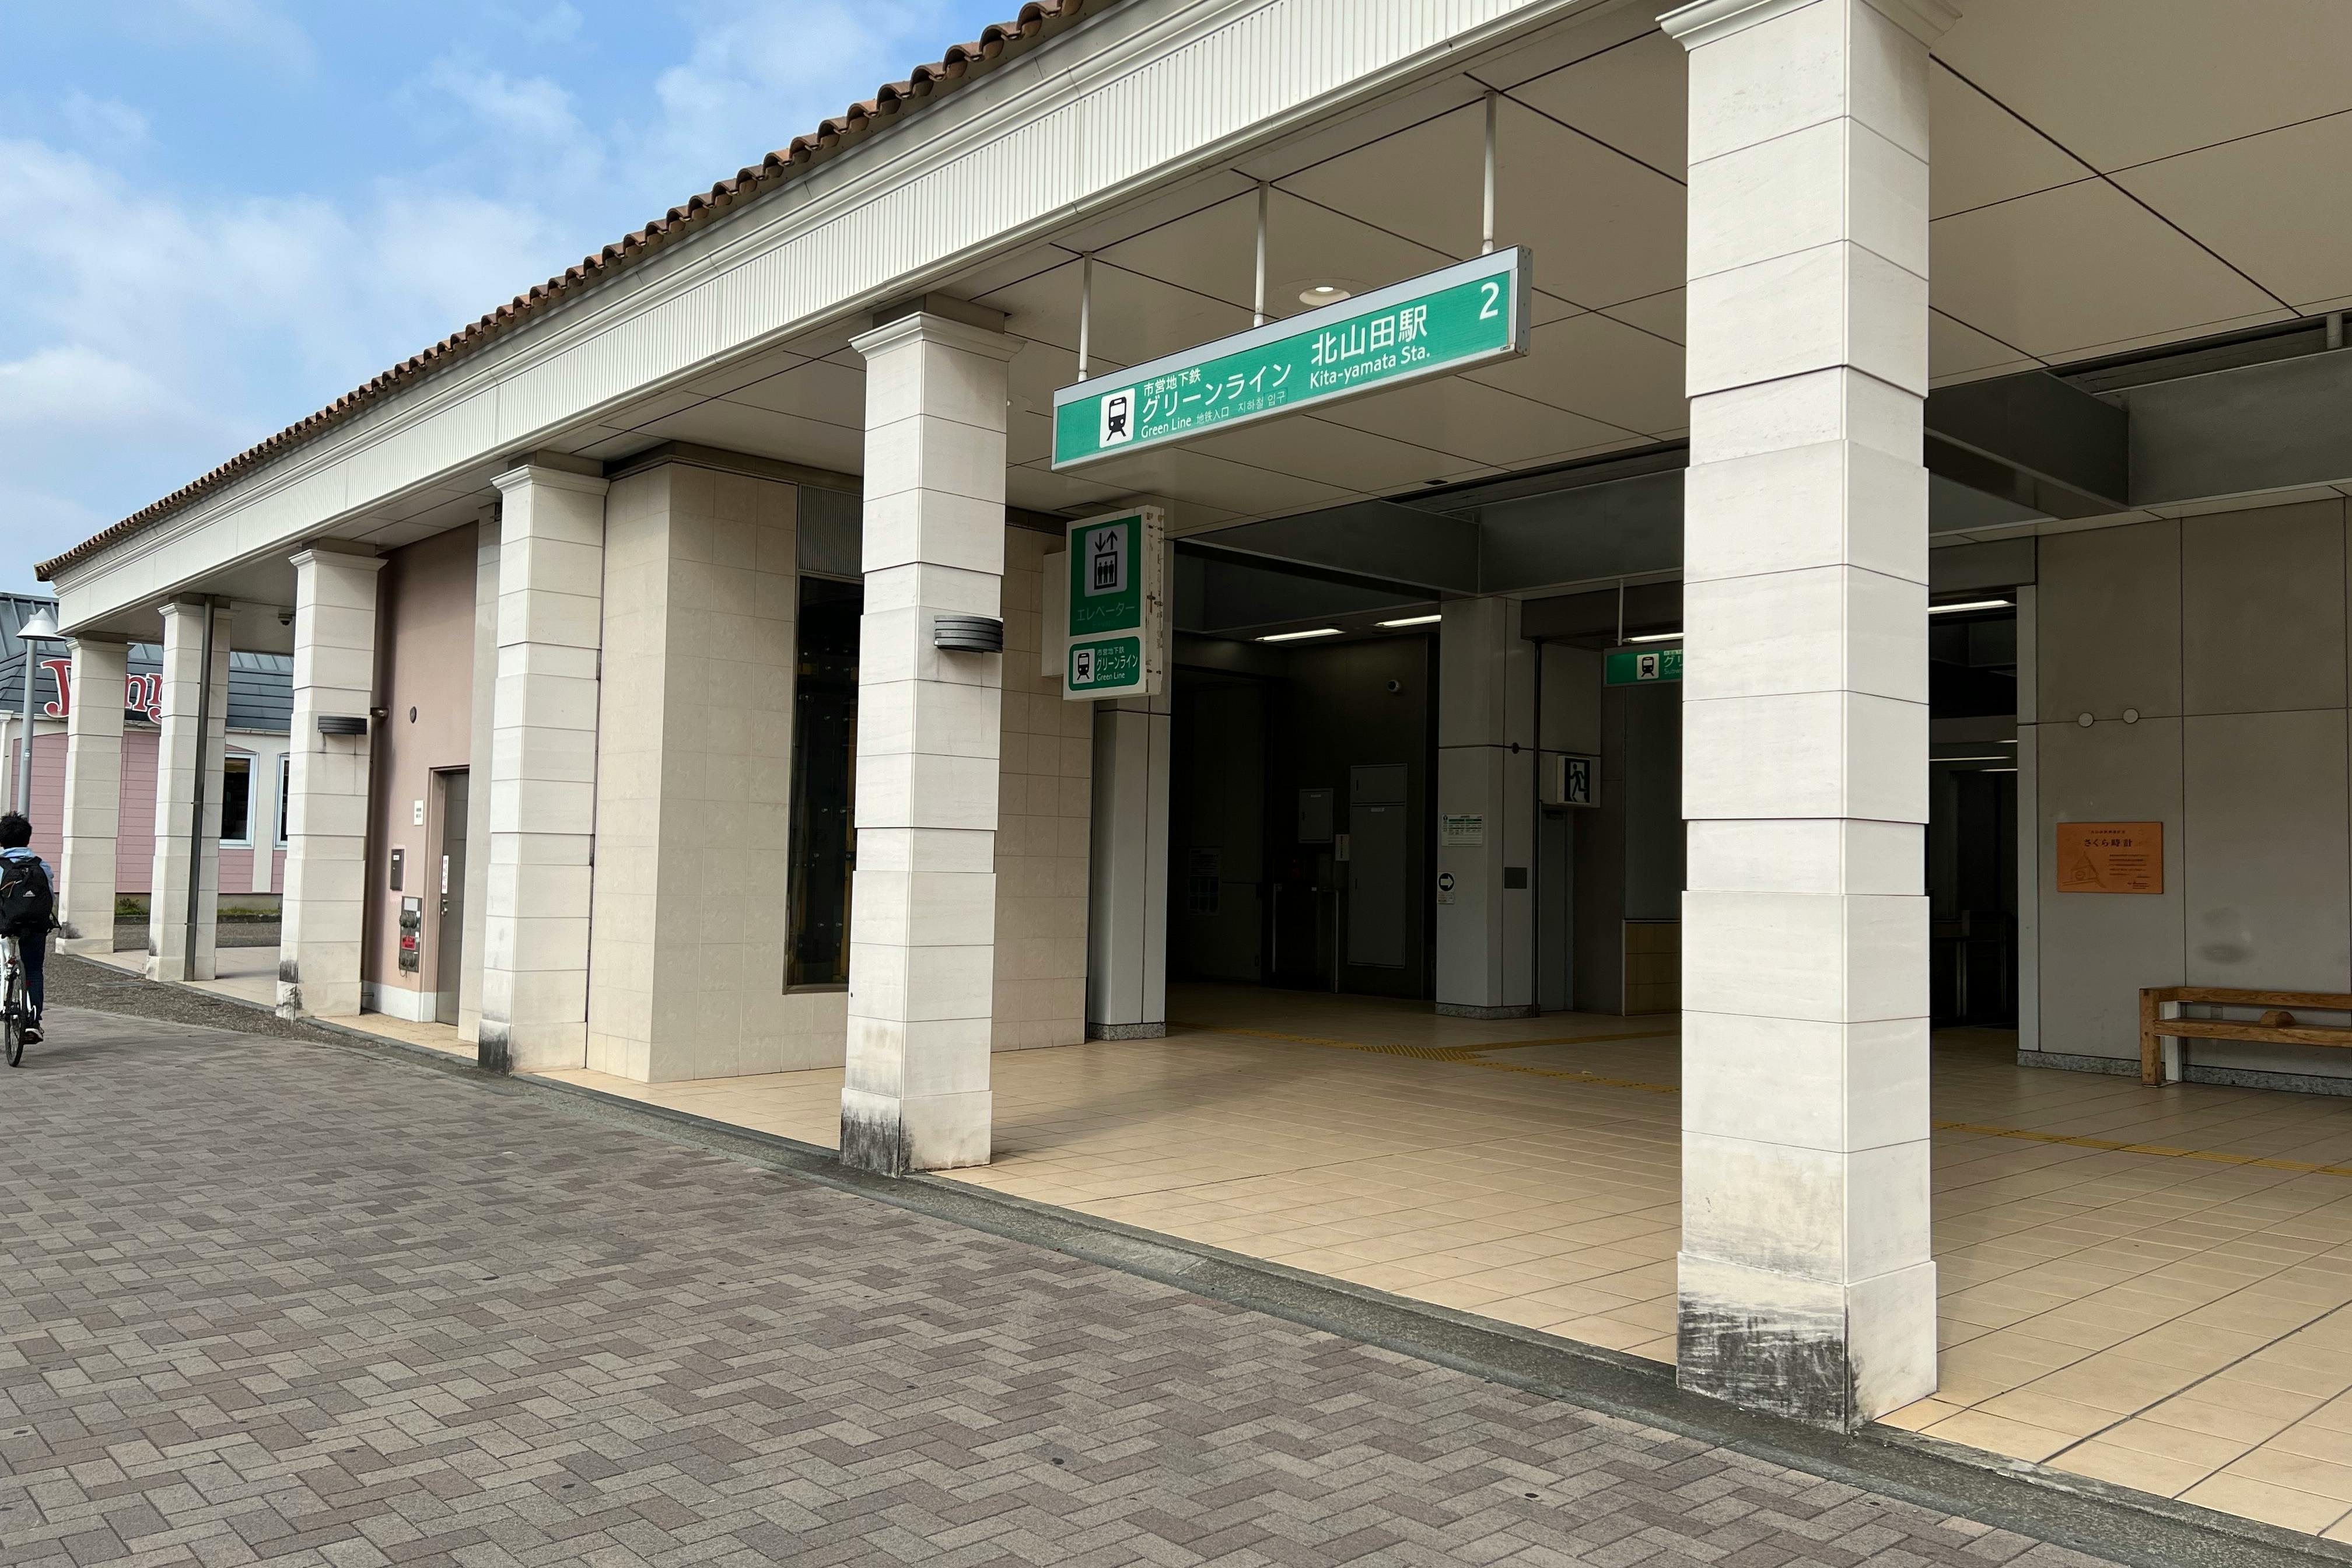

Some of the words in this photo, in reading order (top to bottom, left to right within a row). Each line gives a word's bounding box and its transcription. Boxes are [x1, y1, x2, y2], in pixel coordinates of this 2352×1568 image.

[1479, 281, 1500, 320] 2
[1310, 304, 1428, 366] 北山田駅
[1309, 354, 1396, 390] Kita-yamata
[1400, 345, 1430, 365] Sta.
[1142, 363, 1292, 423] グリーンライン
[1143, 368, 1201, 397] 市営地下鉄
[1238, 397, 1265, 414] 지하철
[1267, 390, 1286, 407] 입구
[1141, 423, 1169, 438] Green
[1171, 416, 1191, 431] Line
[1076, 601, 1136, 622] エレベーター
[1097, 654, 1138, 671] グリーンライン
[1097, 673, 1113, 681] Green
[1114, 671, 1125, 680] Line
[2084, 838, 2133, 847] さくら時計
